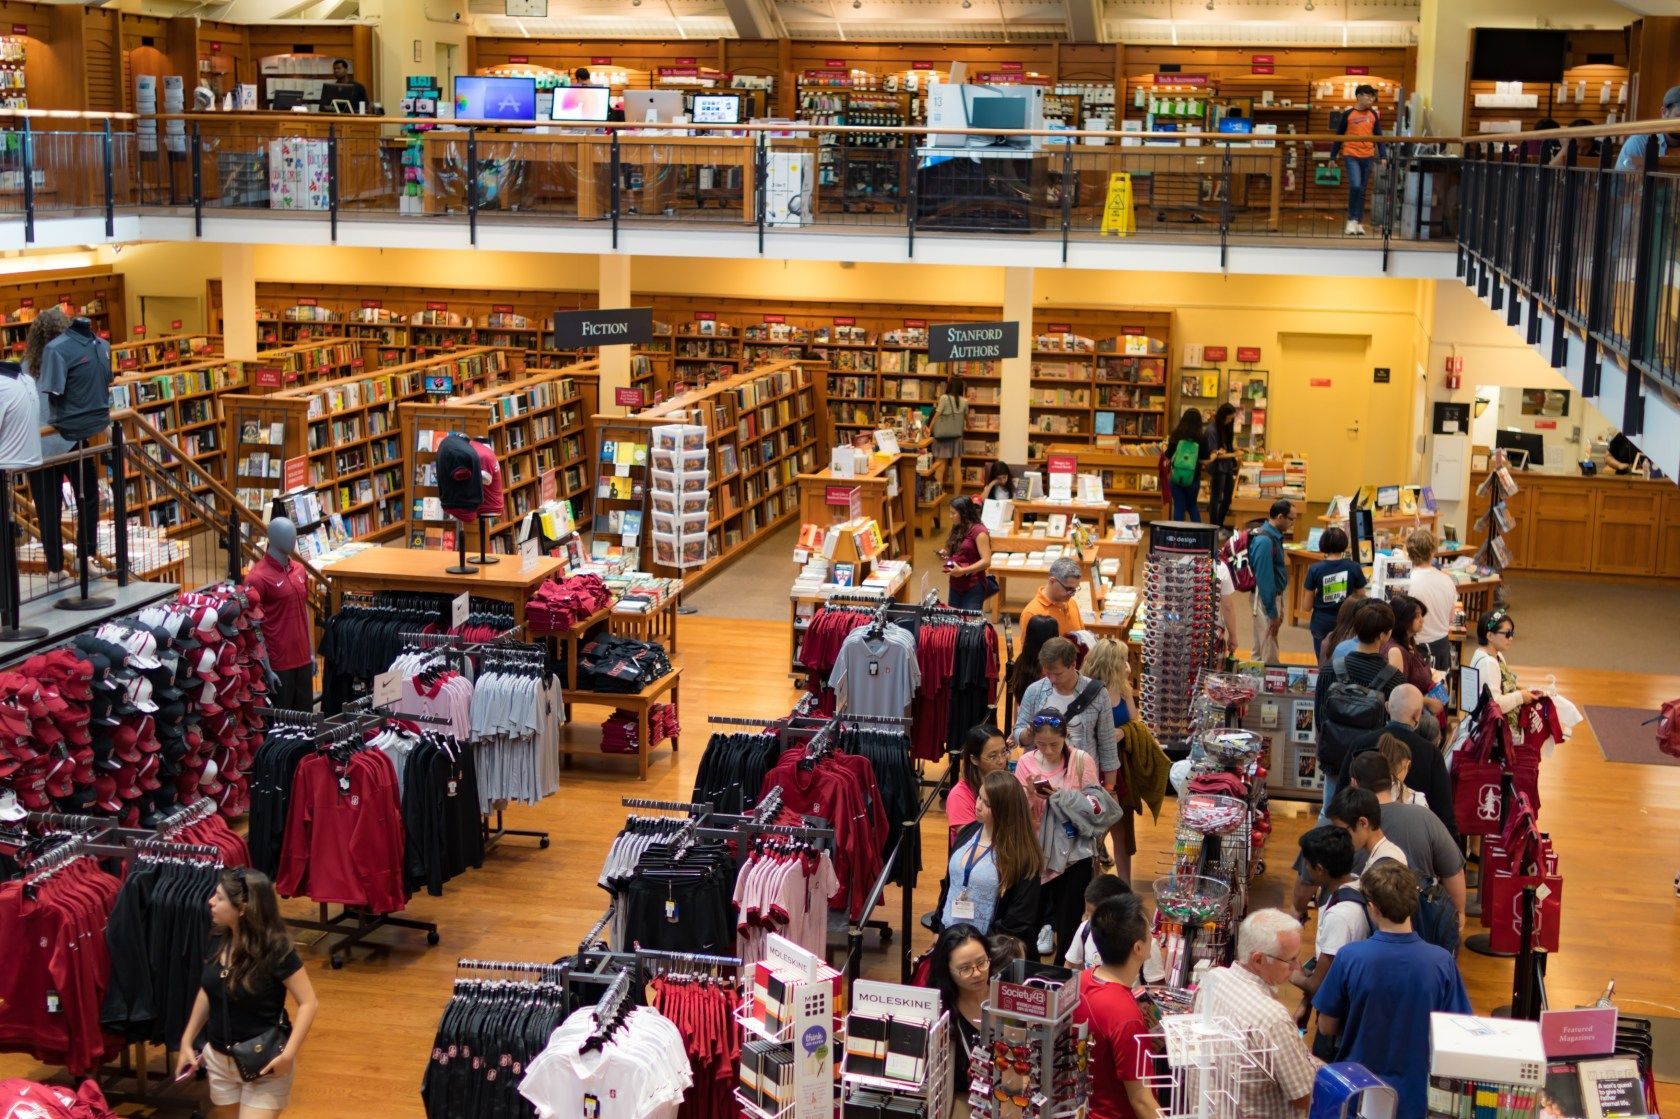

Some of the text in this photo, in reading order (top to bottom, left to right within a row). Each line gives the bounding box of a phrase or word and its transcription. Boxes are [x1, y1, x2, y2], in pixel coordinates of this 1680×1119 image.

[1176, 534, 1197, 544] design
[1325, 575, 1337, 584] DARE
[770, 946, 809, 974] MOLESKINE
[858, 993, 932, 1010] MOLESKINE
[1563, 1025, 1593, 1033] Featured
[805, 1032, 824, 1043] think
[1559, 1034, 1596, 1043] Magazines
[1617, 1081, 1633, 1090] quest
[1606, 1089, 1616, 1097] give
